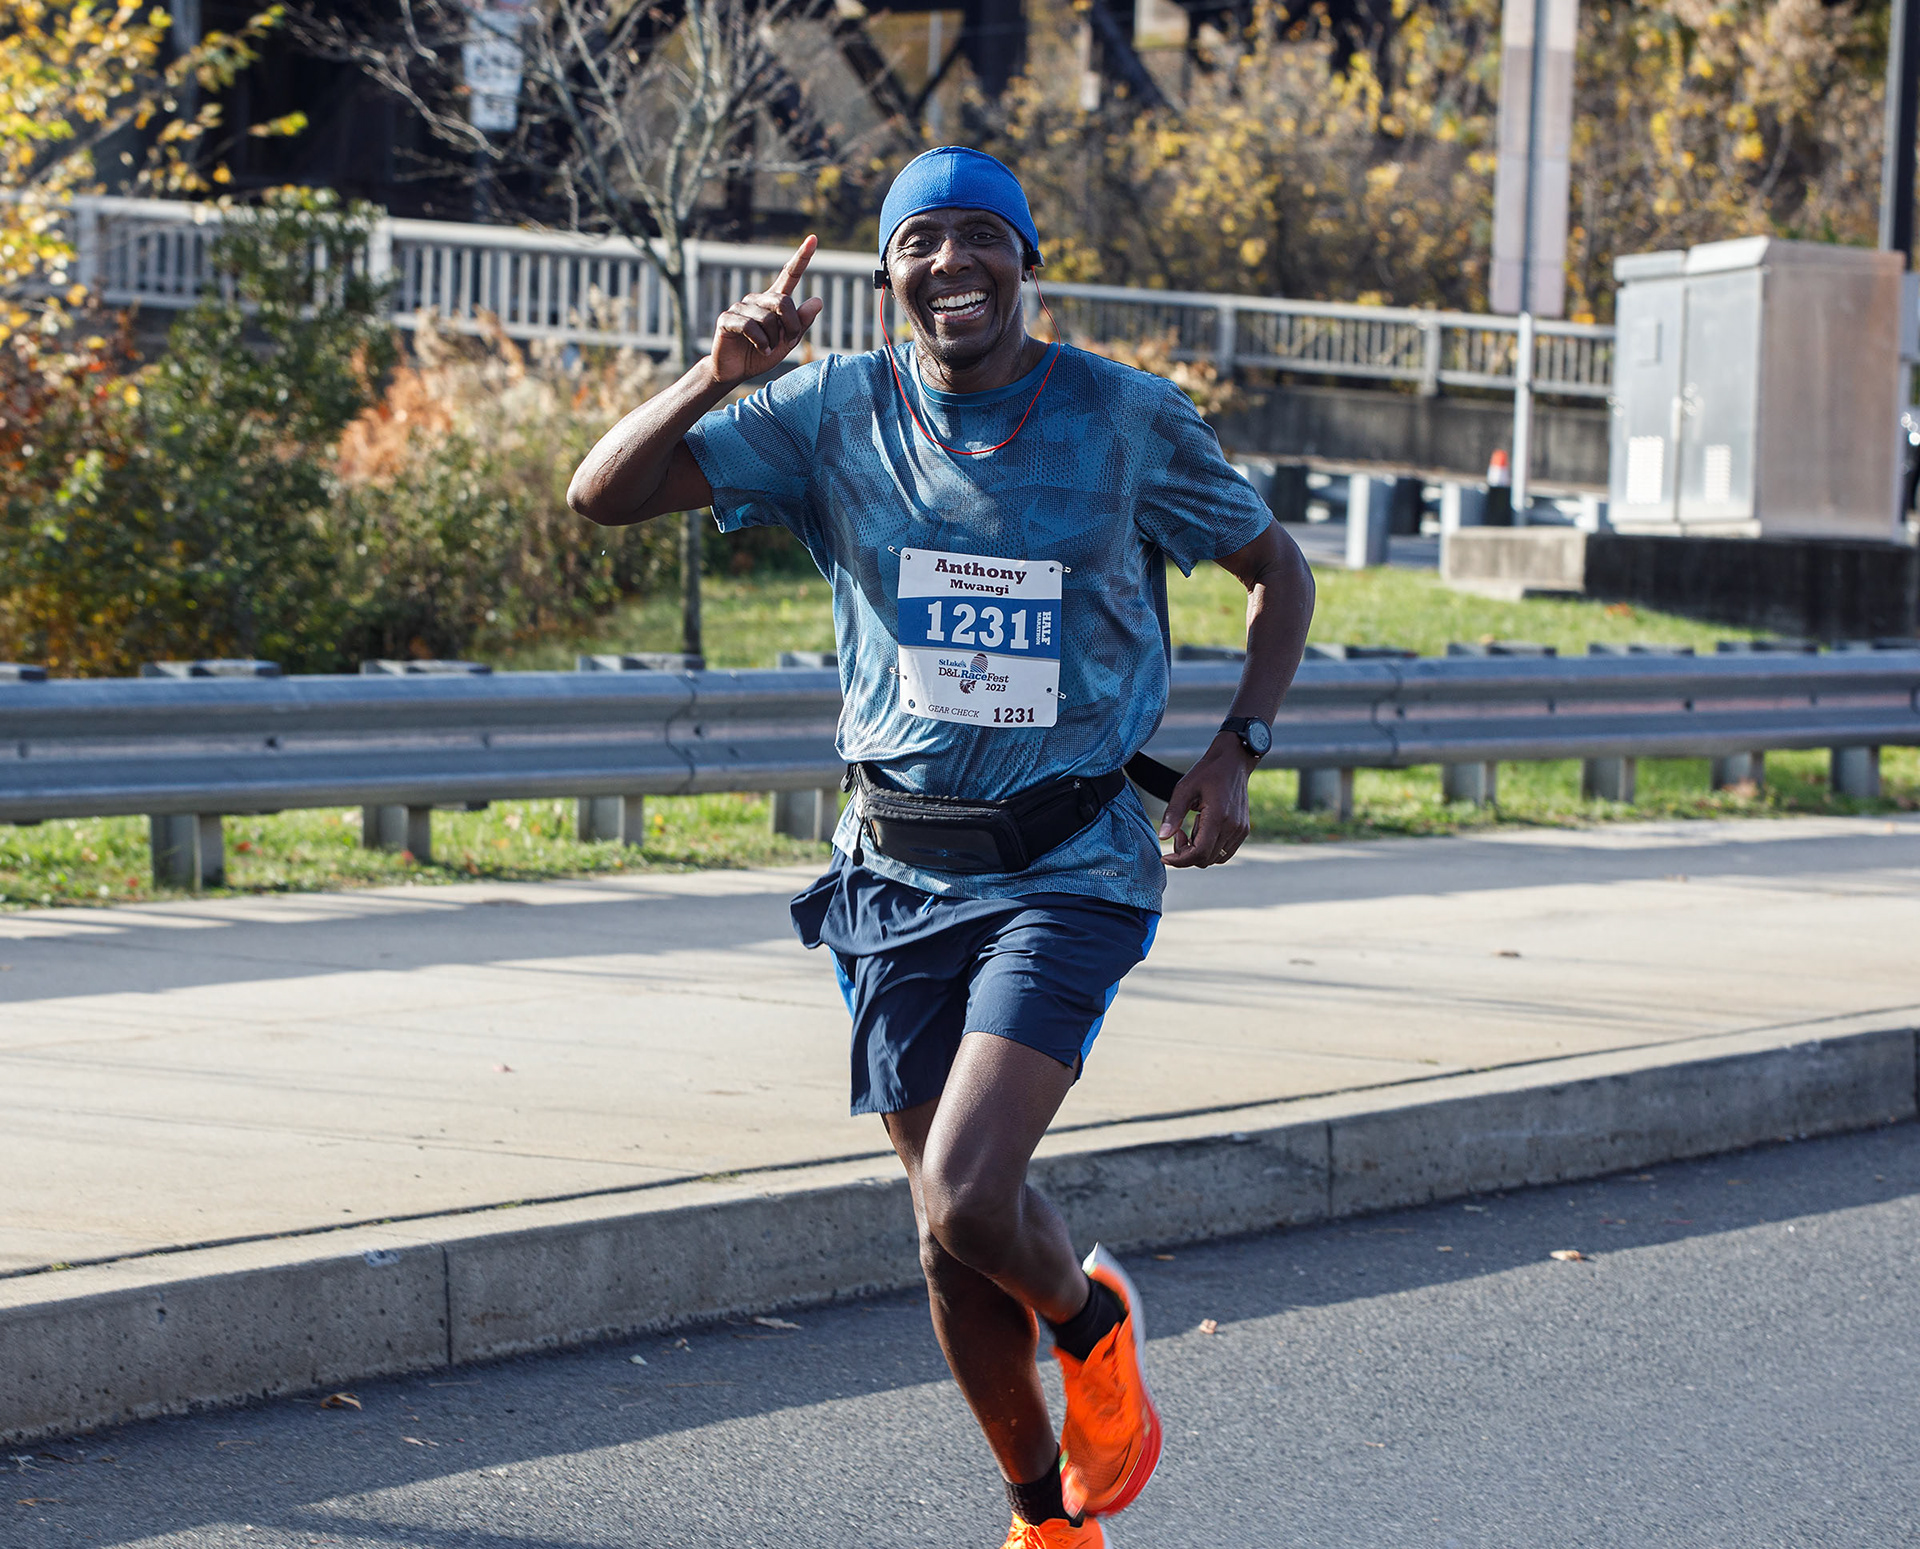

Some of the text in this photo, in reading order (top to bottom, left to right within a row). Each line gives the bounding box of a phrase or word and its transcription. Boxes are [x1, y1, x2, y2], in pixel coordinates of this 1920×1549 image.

[934, 558, 1027, 584] Anthony
[950, 579, 1010, 596] Mwangi
[926, 600, 1029, 650] 1231
[1042, 611, 1052, 646] HALF
[985, 683, 1007, 692] 2023
[928, 704, 980, 718] GEAR CHECK
[993, 707, 1035, 723] 1231
